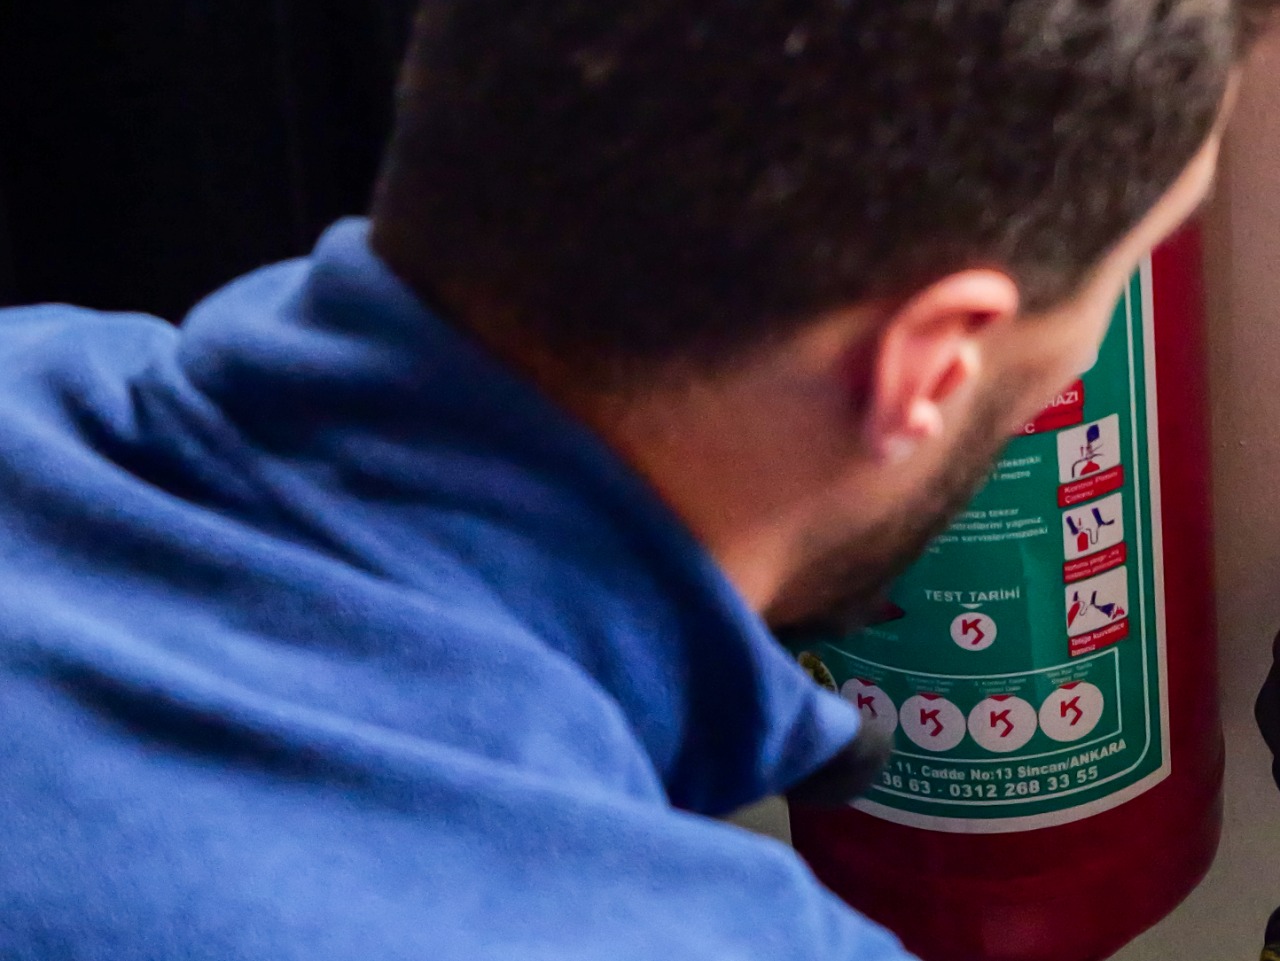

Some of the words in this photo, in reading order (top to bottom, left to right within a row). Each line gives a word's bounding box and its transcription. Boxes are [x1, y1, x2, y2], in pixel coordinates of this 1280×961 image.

[924, 589, 963, 602] TEST
[922, 765, 965, 780] Cadde
[970, 767, 1012, 781] No:13
[1018, 738, 1127, 775] Sincan/ANKARA
[908, 779, 931, 794] 63
[949, 783, 998, 798] 0312
[1004, 780, 1041, 795] 268
[1047, 773, 1070, 791] 33
[1076, 765, 1099, 785] 55
